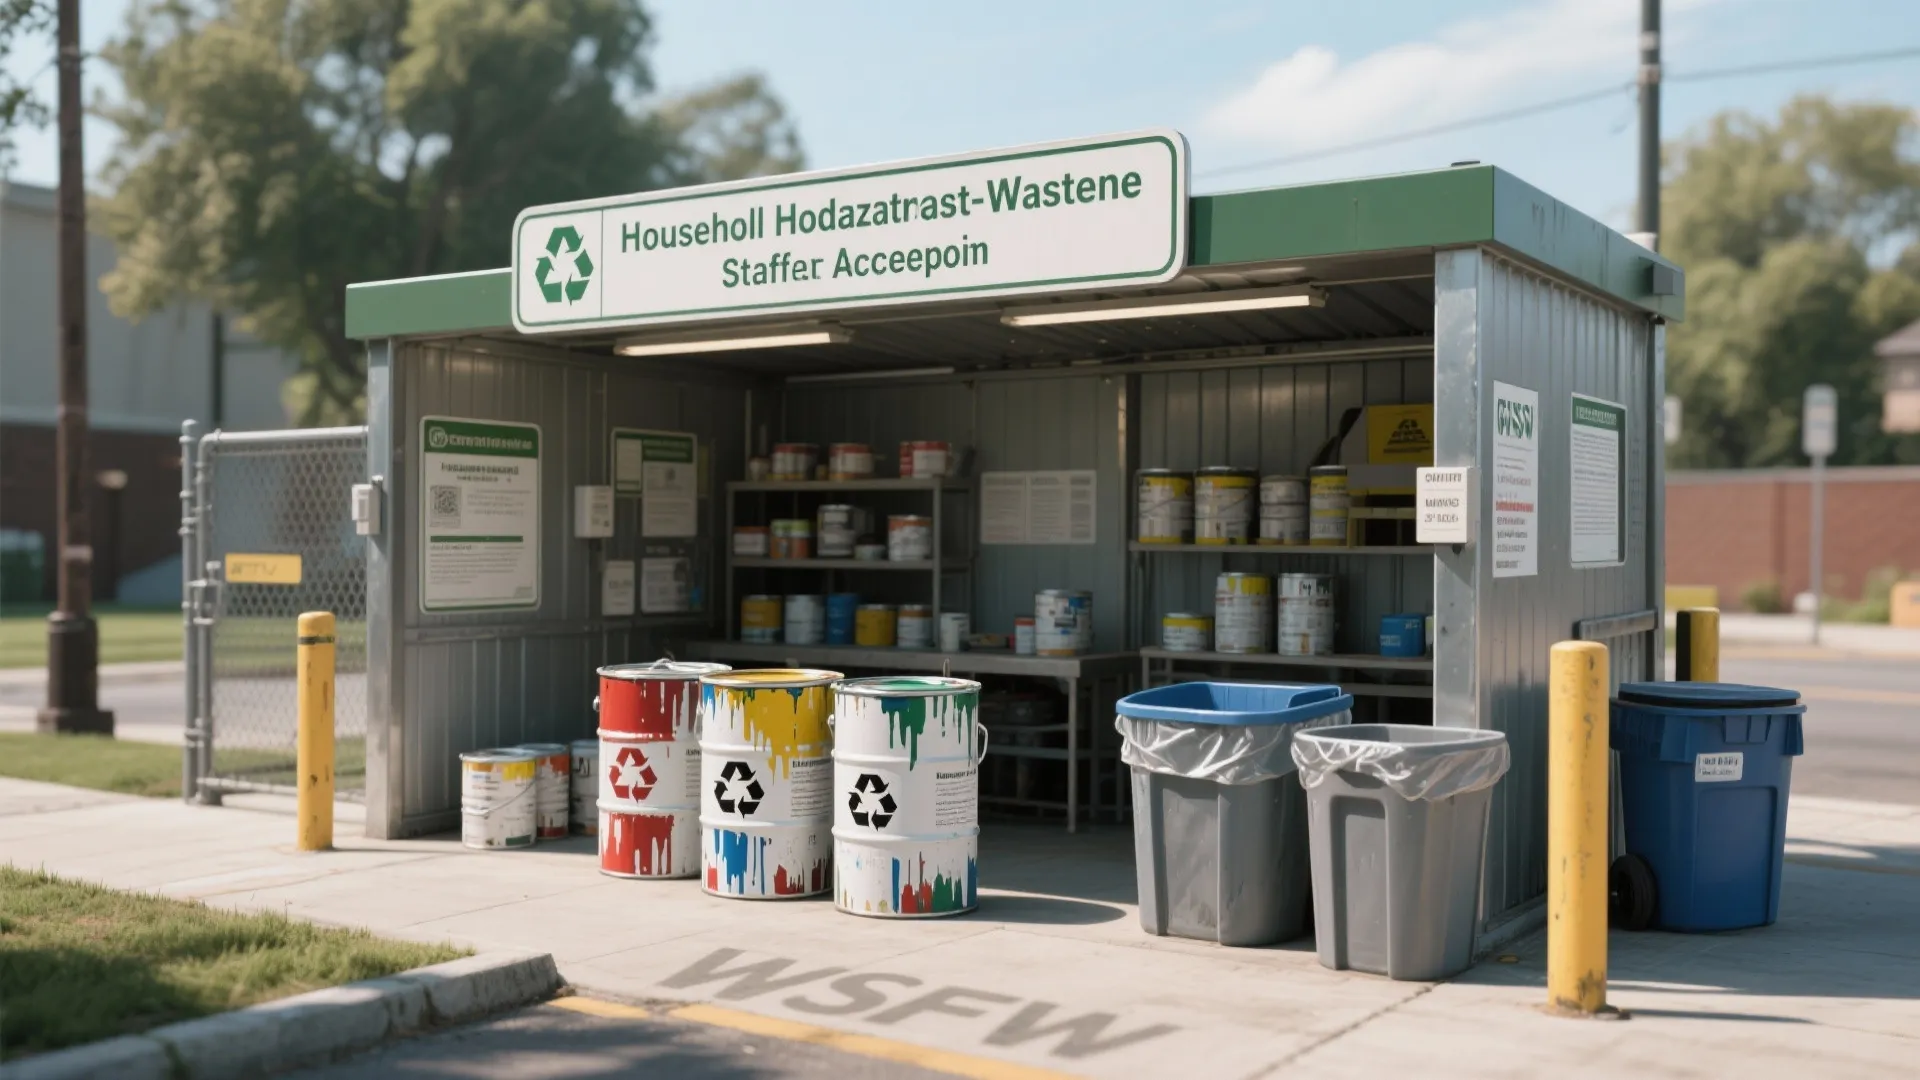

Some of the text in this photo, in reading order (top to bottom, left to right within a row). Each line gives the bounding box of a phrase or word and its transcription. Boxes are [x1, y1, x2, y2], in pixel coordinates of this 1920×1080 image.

[621, 206, 765, 253] Householl
[721, 234, 989, 289] Staffer Acceepoin
[657, 947, 1180, 1060] WSFW
